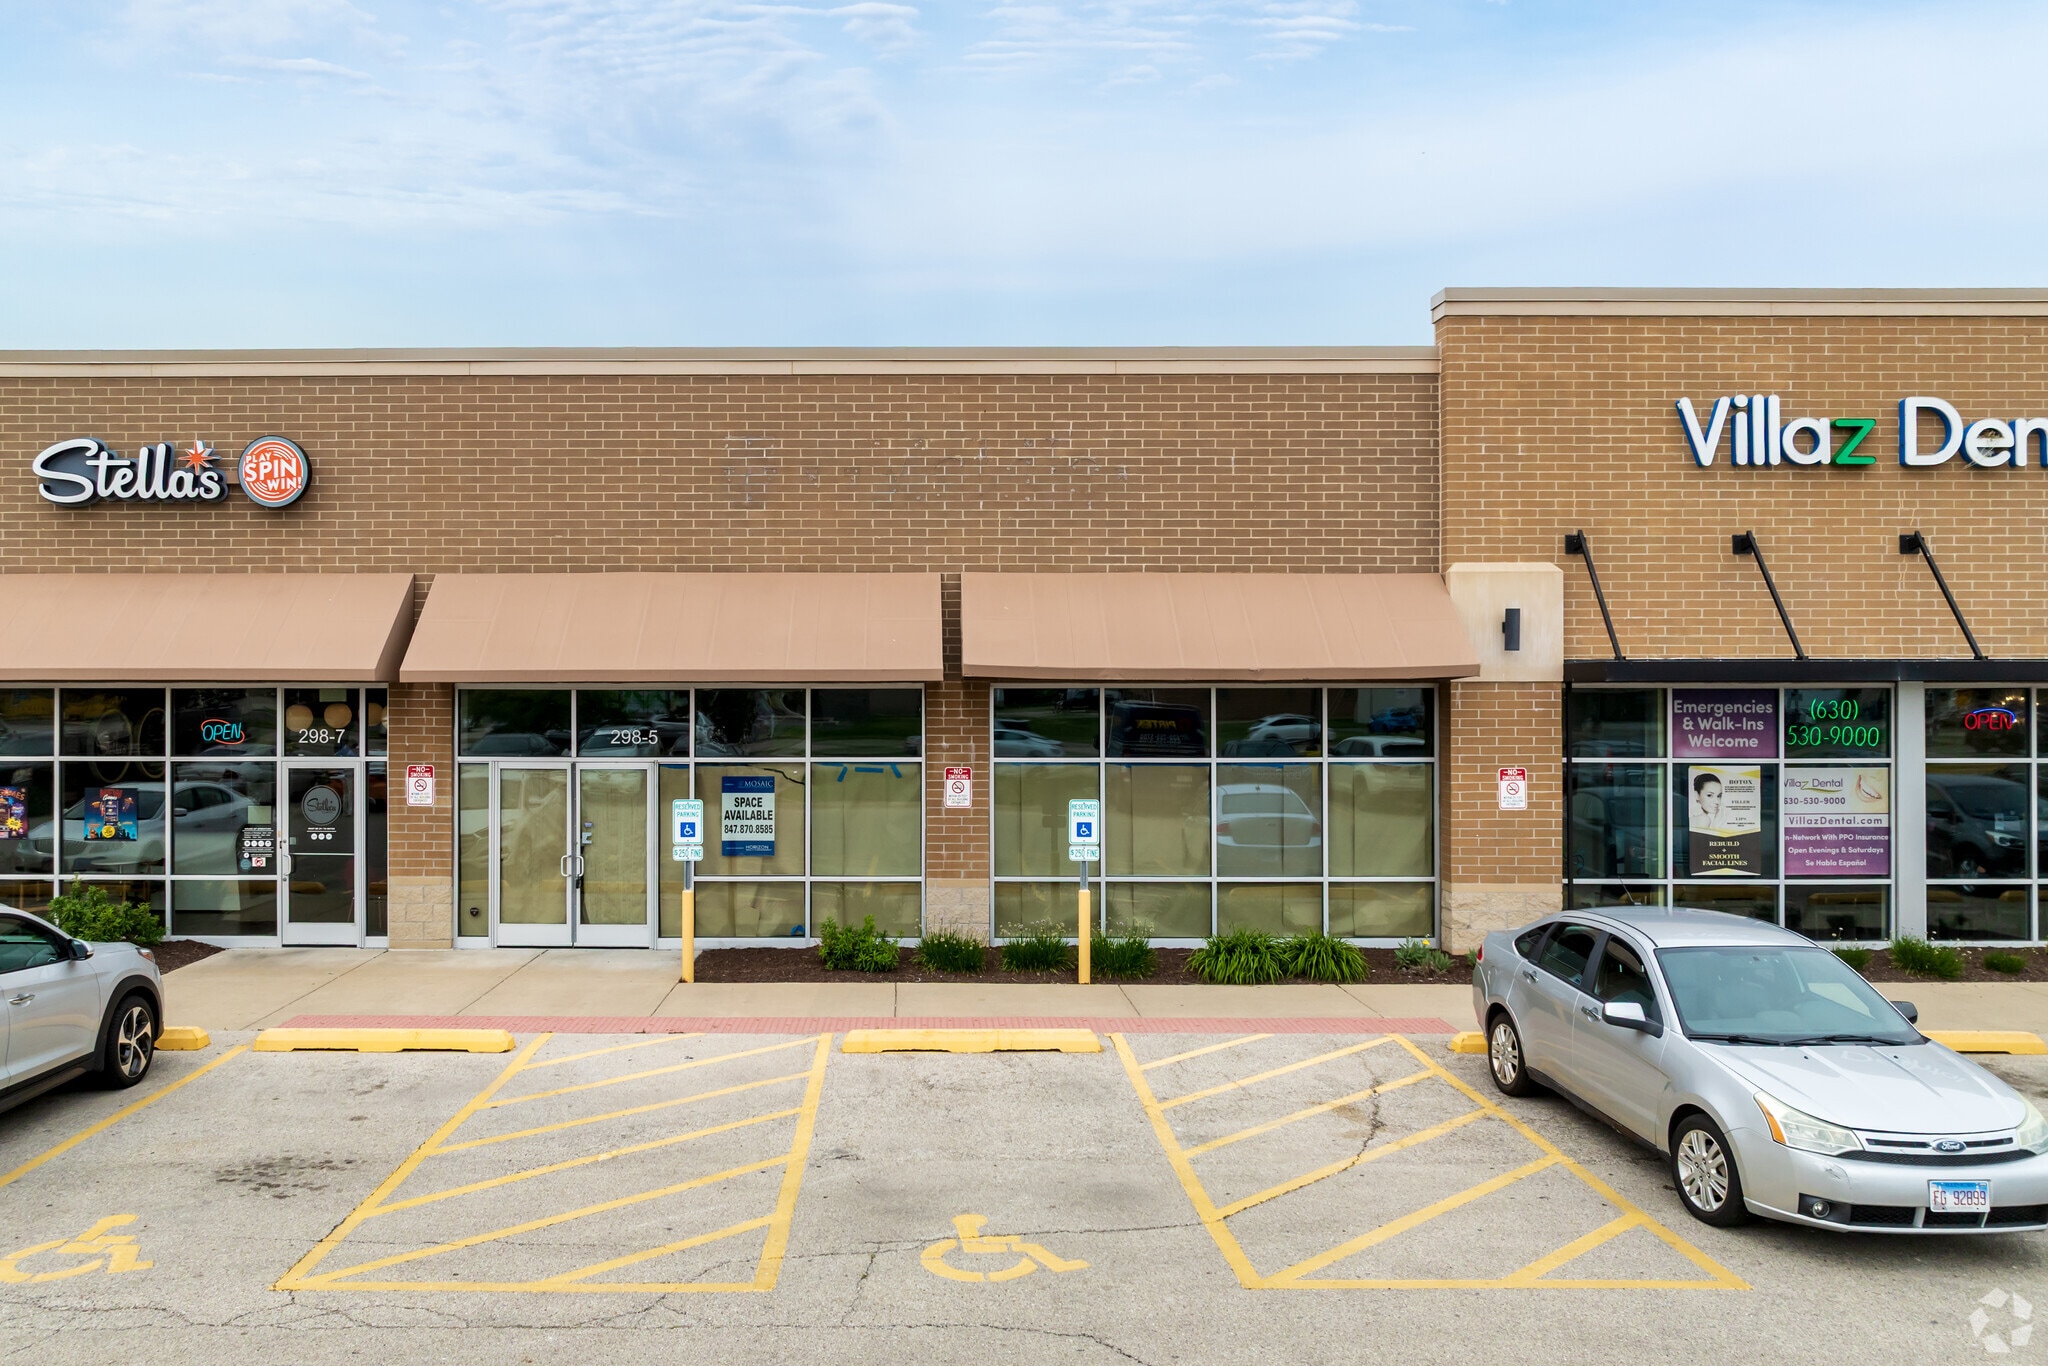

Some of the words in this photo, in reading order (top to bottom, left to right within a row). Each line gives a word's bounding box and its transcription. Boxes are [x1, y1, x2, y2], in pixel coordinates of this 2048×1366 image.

[1676, 394, 1877, 467] Villaz
[245, 452, 271, 464] PLAY
[244, 457, 297, 482] SPIN
[266, 476, 302, 491] WIN!
[1674, 701, 1773, 717] Emergencies
[1810, 698, 1859, 721] (630)
[1682, 717, 1694, 730] &
[1697, 717, 1764, 730] Walk-Ins
[1964, 713, 2013, 730] OPEN
[202, 722, 242, 741] OPEN
[298, 728, 346, 744] 298-7
[610, 729, 658, 744] 298-5
[1786, 725, 1880, 747] 530-9000
[1688, 734, 1759, 748] Welcome
[744, 780, 774, 788] MOSAIC
[1812, 778, 1843, 787] Dental
[734, 797, 763, 807] SPACE
[724, 810, 773, 820] AVAILABLE
[1788, 816, 1883, 825] VillazDental.com
[724, 825, 773, 833] 847.870.8585
[691, 849, 702, 857] FINE
[1086, 849, 1098, 857] FINE
[1808, 847, 1840, 855] Evenings
[1941, 1141, 1961, 1151] Ford
[1933, 1190, 1947, 1206] FG
[1953, 1190, 1987, 1206] 92899
